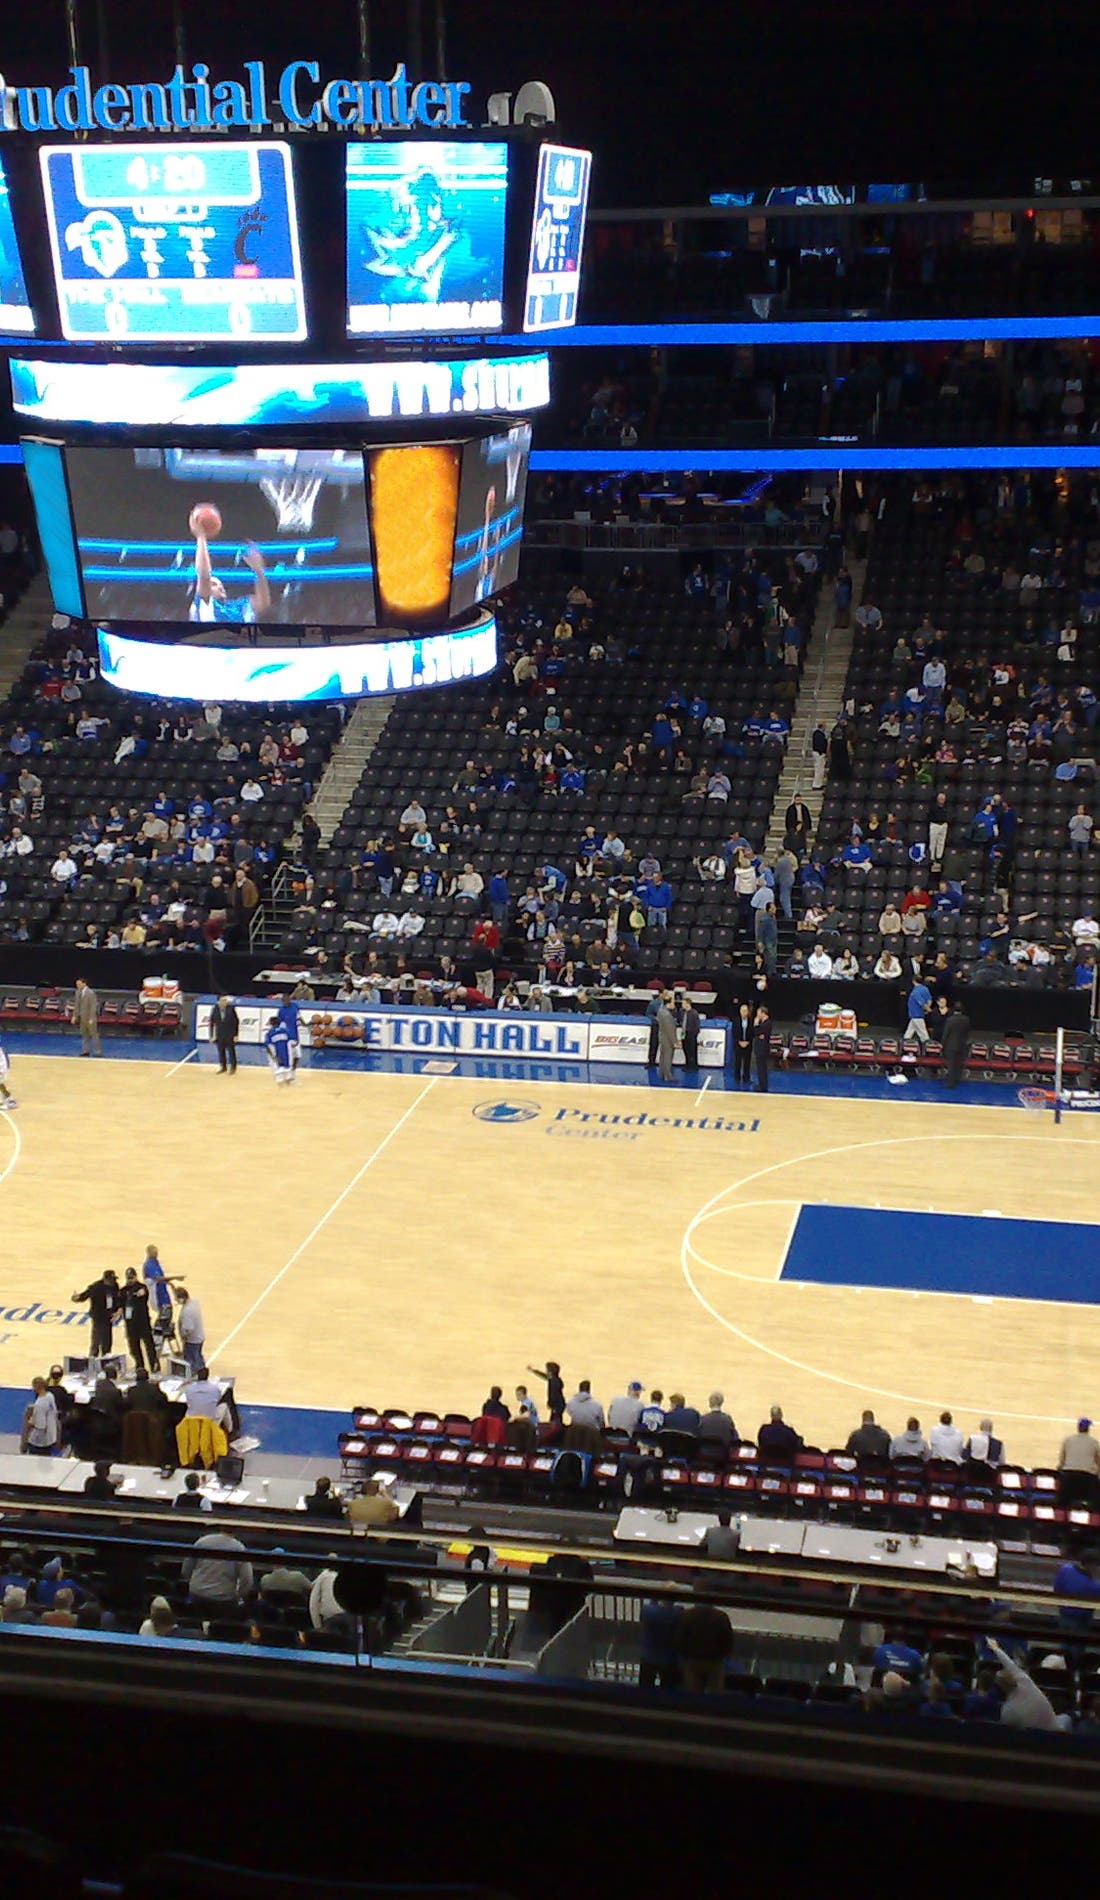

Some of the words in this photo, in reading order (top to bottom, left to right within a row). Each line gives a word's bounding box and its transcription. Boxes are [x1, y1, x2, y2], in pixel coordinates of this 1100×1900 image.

[279, 60, 472, 127] Center
[473, 1022, 580, 1054] HALL
[618, 1036, 648, 1046] EAS
[554, 1108, 761, 1132] Prudential
[545, 1124, 644, 1141] Center
